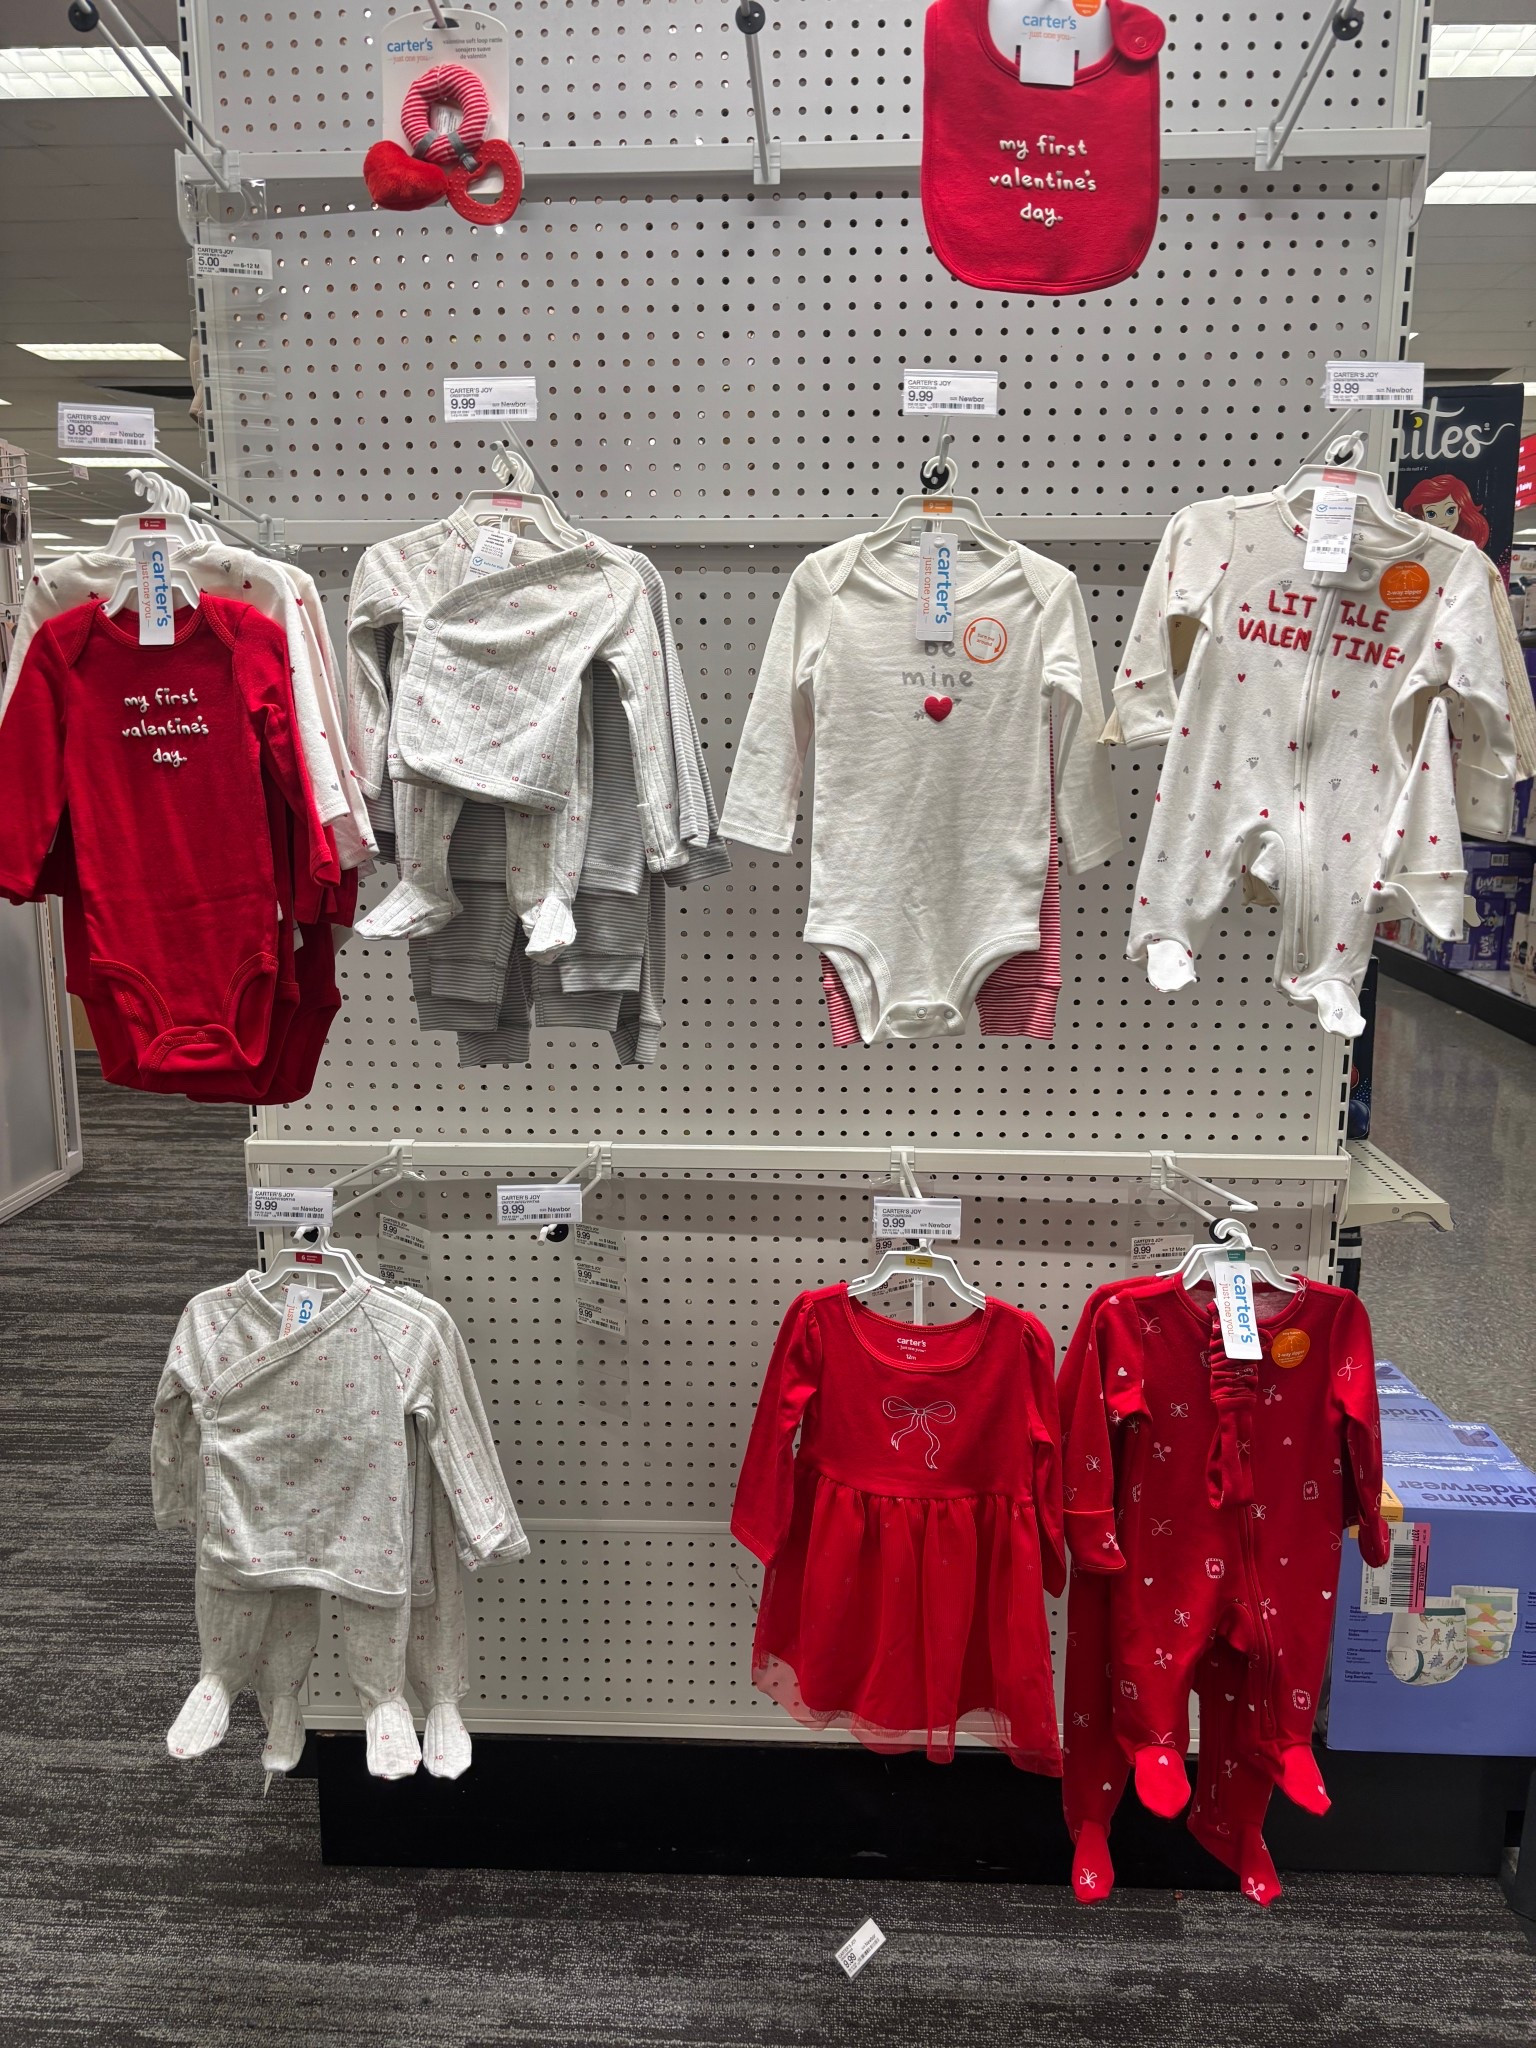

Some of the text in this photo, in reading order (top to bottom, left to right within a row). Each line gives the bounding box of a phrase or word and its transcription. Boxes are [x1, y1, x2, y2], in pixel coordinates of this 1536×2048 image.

[475, 22, 487, 30] 0+
[1022, 15, 1077, 30] carter's
[387, 38, 433, 52] carter's
[1000, 135, 1087, 160] my first
[989, 167, 1097, 191] valentine's
[1020, 202, 1063, 227] day.
[198, 247, 222, 255] CARTER'S
[198, 256, 220, 267] 5.00
[908, 390, 933, 402] 9.99
[1333, 383, 1359, 394] 9.99
[450, 398, 476, 409] 9.99
[67, 424, 93, 436] 9.99
[138, 561, 149, 580] just
[923, 556, 935, 575] just
[142, 581, 151, 599] one
[152, 550, 172, 627] carter's
[923, 577, 931, 595] one
[935, 546, 952, 624] carter's
[924, 640, 956, 657] be
[902, 666, 974, 688] mine
[124, 687, 199, 713] my first
[122, 715, 209, 737] valentine's
[152, 748, 188, 768] day.
[255, 1200, 278, 1211] 9.99
[502, 1204, 525, 1215] 9.99
[383, 1224, 398, 1235] 9.99
[882, 1218, 905, 1228] 9.99
[576, 1230, 590, 1240] 9.99
[875, 1240, 892, 1250] 9.99
[1133, 1246, 1151, 1254] 9.99
[380, 1270, 395, 1280] 9.99
[577, 1270, 592, 1280] 9.99
[1219, 1283, 1231, 1301] just
[286, 1304, 295, 1322] just
[578, 1308, 593, 1318] 9.99
[1224, 1302, 1232, 1318] one
[1233, 1274, 1256, 1344] carter's
[897, 1338, 927, 1347] carter's
[1421, 1492, 1536, 1507] ighttime
[1412, 1529, 1420, 1541] 2377
[1418, 1561, 1426, 1591] CONVEYABLE
[843, 1952, 857, 1969] 9.99
